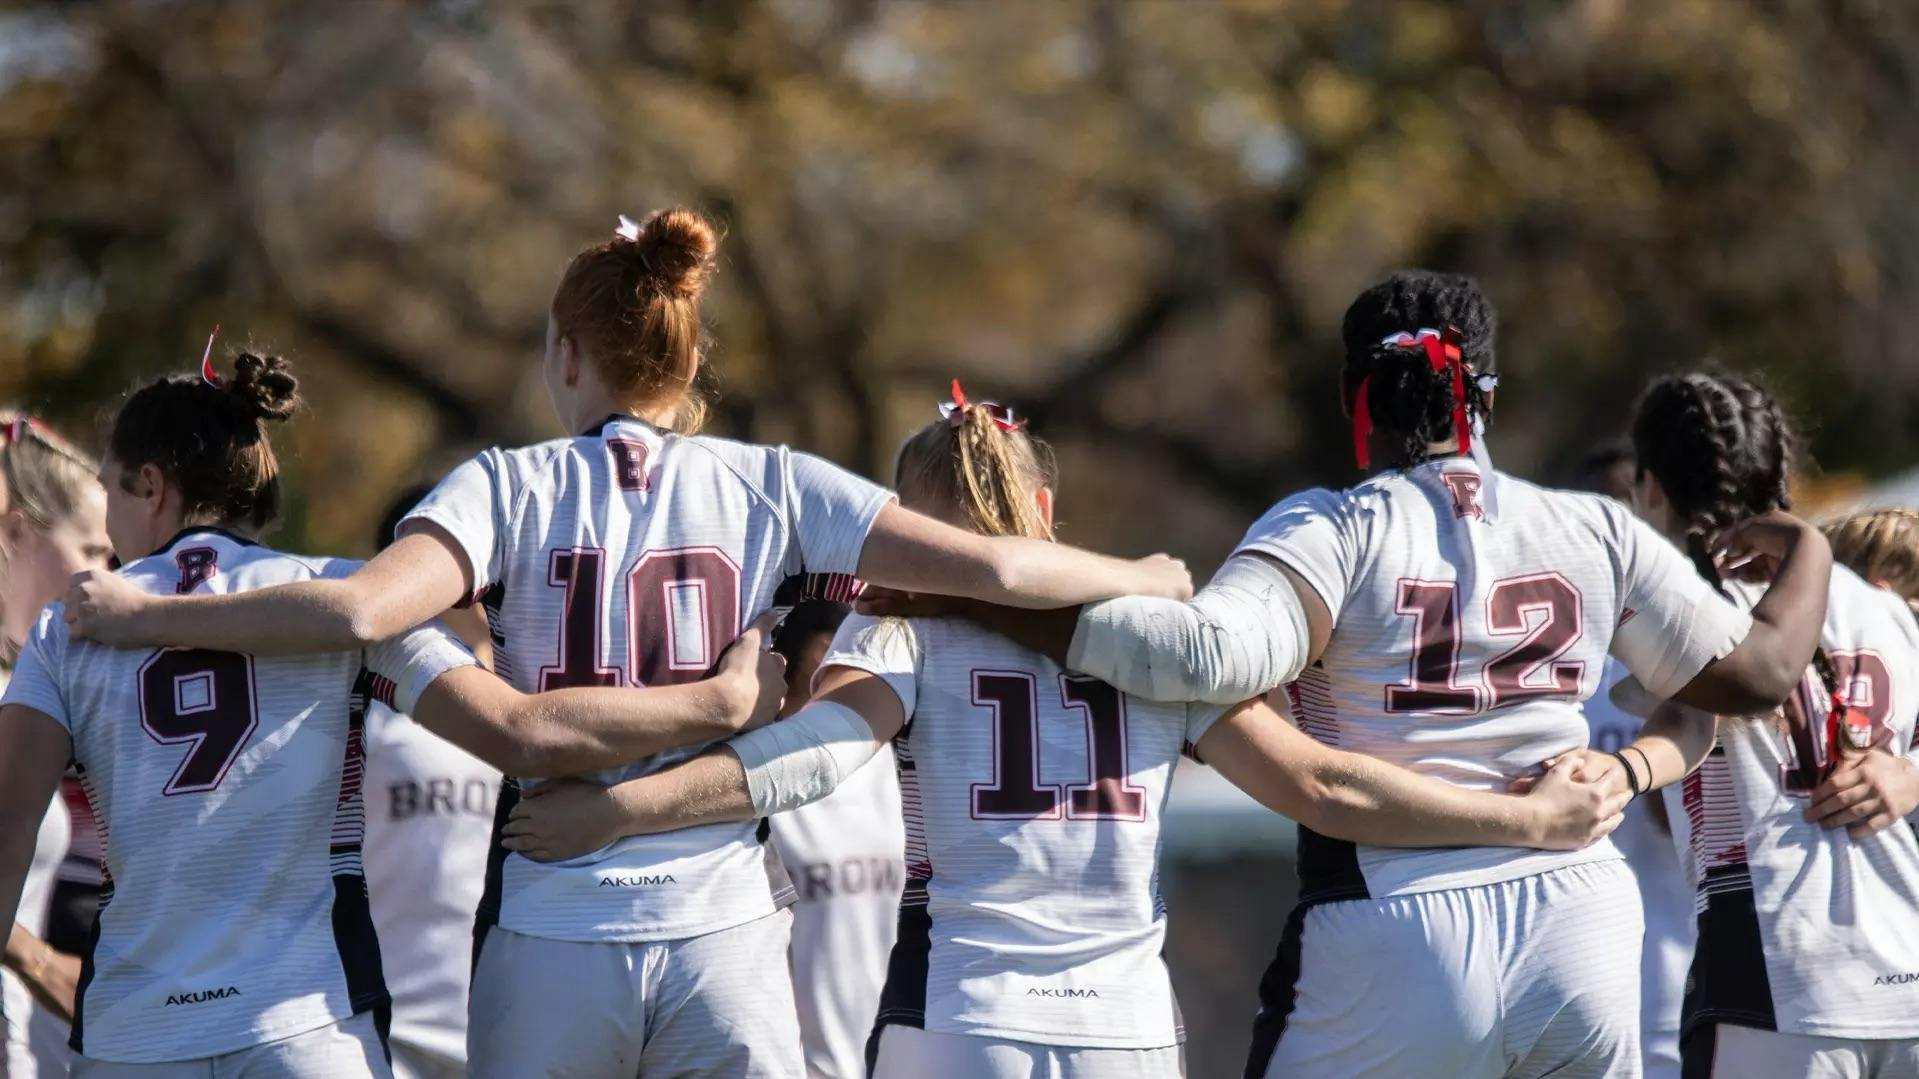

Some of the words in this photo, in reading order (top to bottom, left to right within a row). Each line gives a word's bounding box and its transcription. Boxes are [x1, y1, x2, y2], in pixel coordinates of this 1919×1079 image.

[606, 438, 651, 492] B
[176, 546, 218, 596] B
[538, 546, 742, 690] 10
[1385, 571, 1585, 715] 12
[137, 646, 258, 797] 9
[970, 668, 1146, 822] 11
[599, 874, 677, 887] AKUMA
[164, 986, 241, 1007] AKUMA
[1026, 988, 1100, 998] AKUMA
